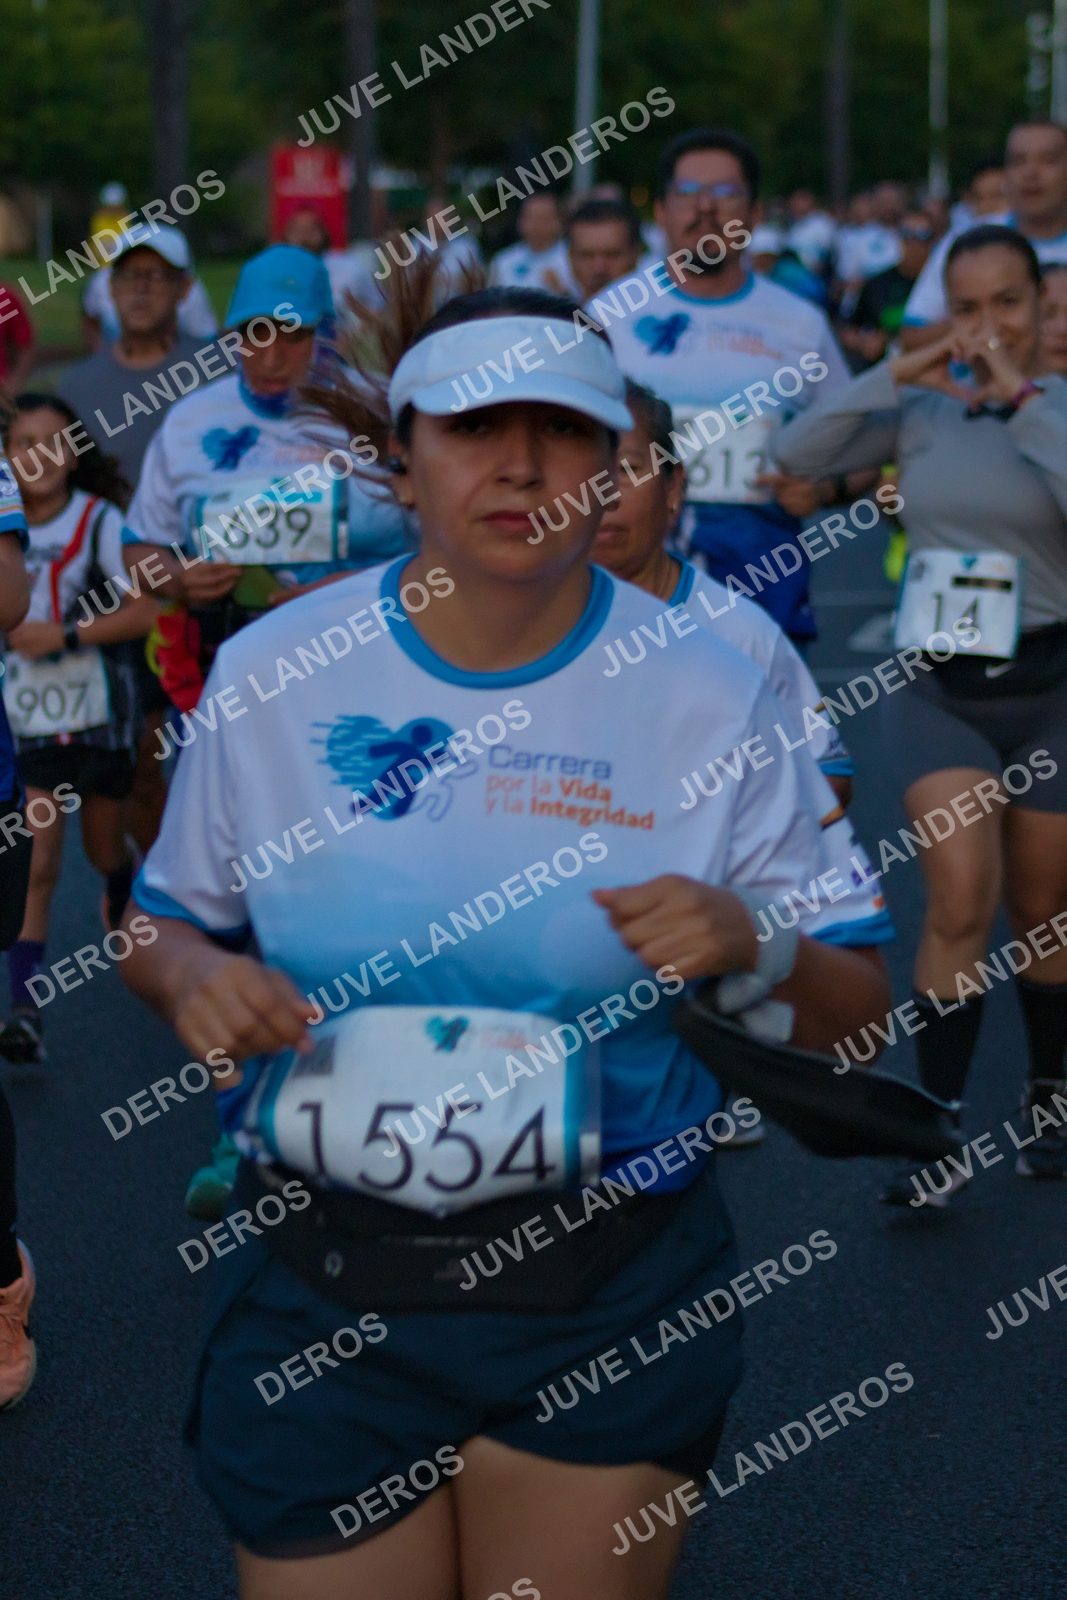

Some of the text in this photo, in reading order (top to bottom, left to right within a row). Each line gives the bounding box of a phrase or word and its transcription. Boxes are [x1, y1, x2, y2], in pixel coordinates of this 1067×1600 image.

[16, 683, 88, 725] 907
[489, 744, 612, 780] Carrera
[560, 778, 612, 804] Vida
[530, 797, 656, 832] Integridad
[298, 1101, 558, 1193] 1554
